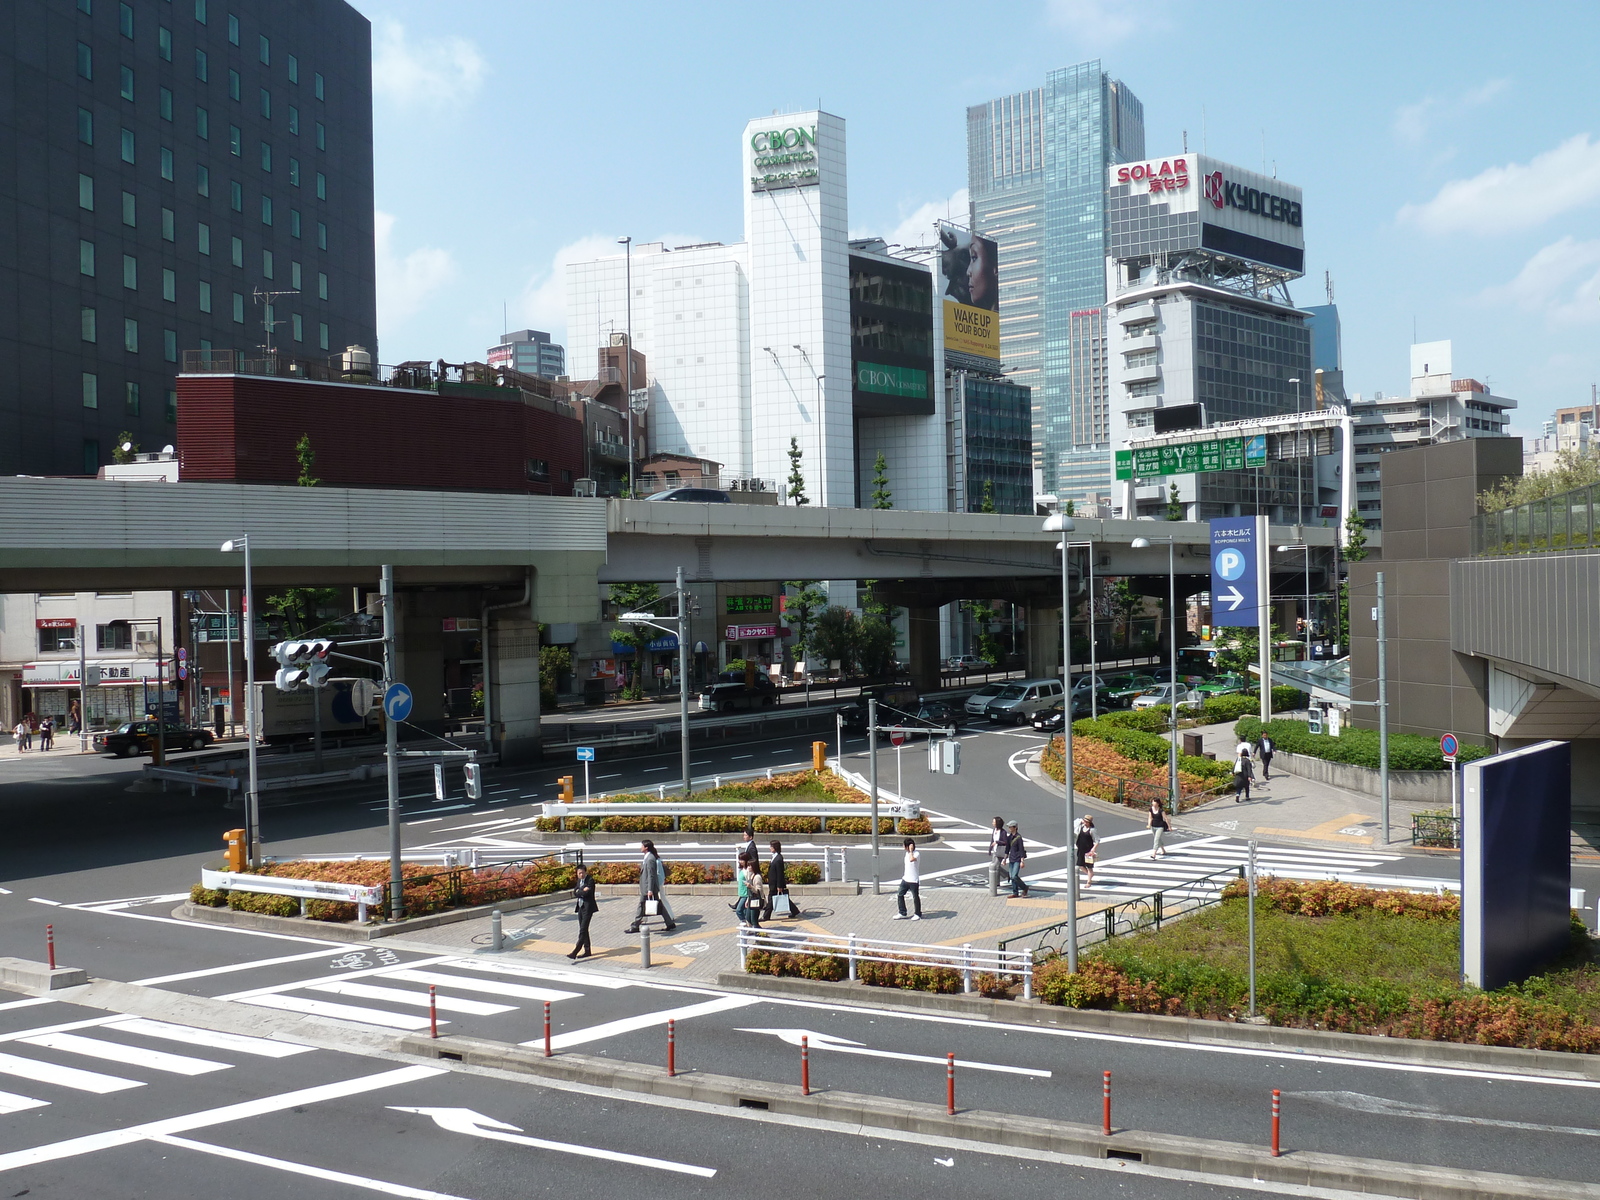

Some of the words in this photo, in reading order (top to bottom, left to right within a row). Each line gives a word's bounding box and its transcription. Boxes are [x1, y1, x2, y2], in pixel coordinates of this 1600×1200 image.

[754, 151, 814, 167] COSMETICS
[1117, 158, 1188, 182] SOLAR
[1149, 174, 1188, 193] 京セラ
[954, 308, 978, 325] WAKE
[980, 314, 991, 327] UP
[954, 322, 972, 334] YOUR
[973, 326, 990, 338] BODY
[1214, 528, 1251, 537] 六本木ヒルズ
[1222, 553, 1238, 576] P
